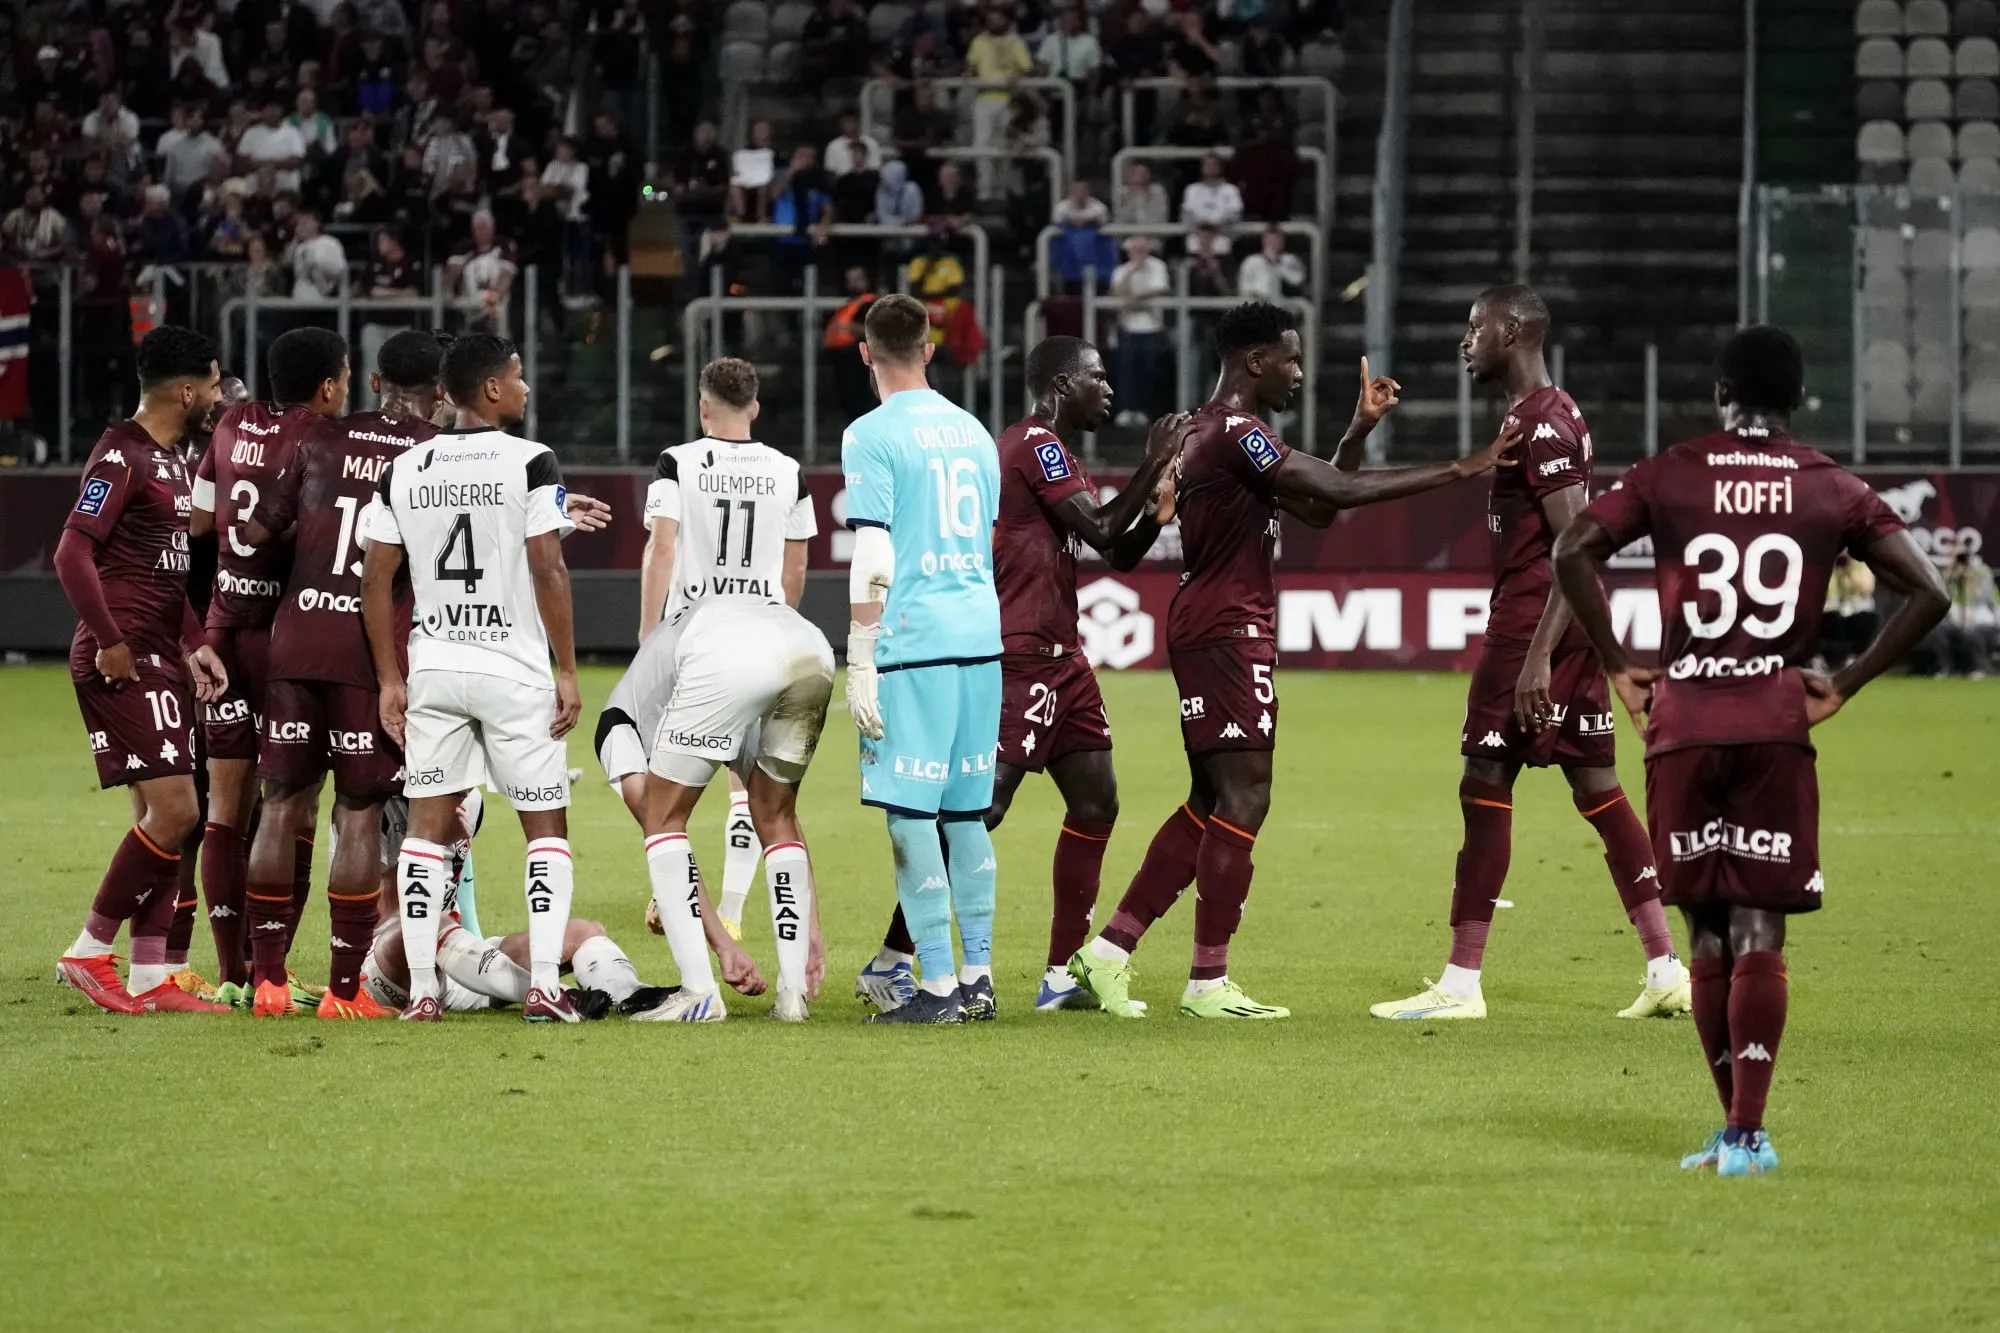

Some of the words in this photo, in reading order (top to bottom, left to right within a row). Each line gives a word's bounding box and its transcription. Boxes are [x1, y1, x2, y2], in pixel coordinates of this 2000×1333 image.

[435, 451, 501, 463] Jardiman.fr
[698, 472, 776, 496] QUEMPER
[929, 457, 981, 539] 16
[1714, 475, 1793, 514] KOFFI
[227, 479, 260, 557] 3
[713, 497, 756, 568] 11
[434, 512, 484, 594] 4
[318, 591, 363, 613] nac
[1682, 532, 1804, 640] 39
[1253, 663, 1274, 704] 5
[145, 689, 181, 731] 10
[1023, 682, 1057, 727] 20
[271, 720, 310, 740] LCR
[341, 731, 374, 750] CR
[729, 813, 755, 850] AG
[1690, 817, 1723, 853] LC
[1735, 825, 1793, 857] LCR
[404, 863, 432, 919] EAG
[527, 861, 554, 913] EAG
[773, 885, 800, 941] EAG
